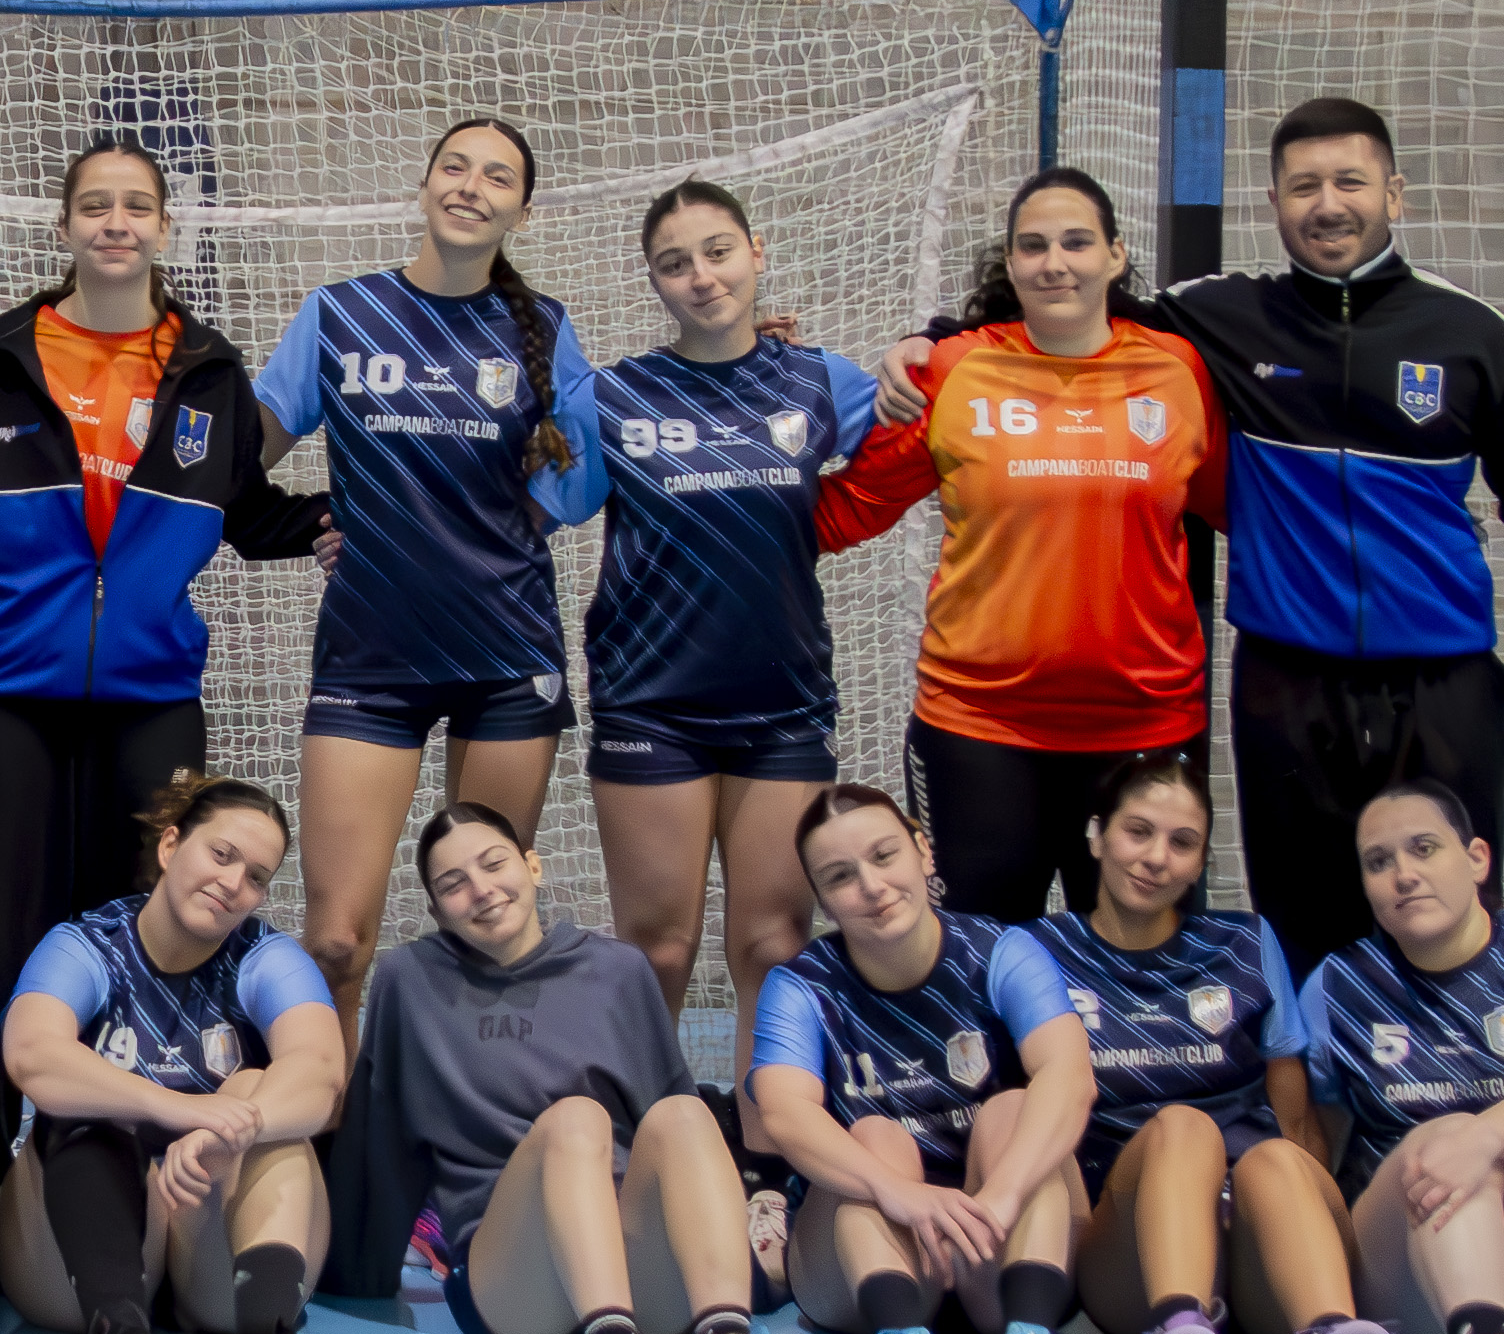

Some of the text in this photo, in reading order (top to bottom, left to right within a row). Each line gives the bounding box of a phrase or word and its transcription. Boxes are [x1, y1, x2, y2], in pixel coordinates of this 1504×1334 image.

[339, 351, 407, 395] 10
[364, 414, 500, 441] CAMPANABOATCLUB
[967, 397, 1039, 437] 16
[620, 417, 698, 459] 99
[662, 466, 802, 496] CAMPANABOATCLUB
[1007, 458, 1150, 481] CAMPANABOATCLUB
[94, 1020, 138, 1071] 19
[477, 1013, 534, 1043] GAP
[1371, 1022, 1410, 1067] 5
